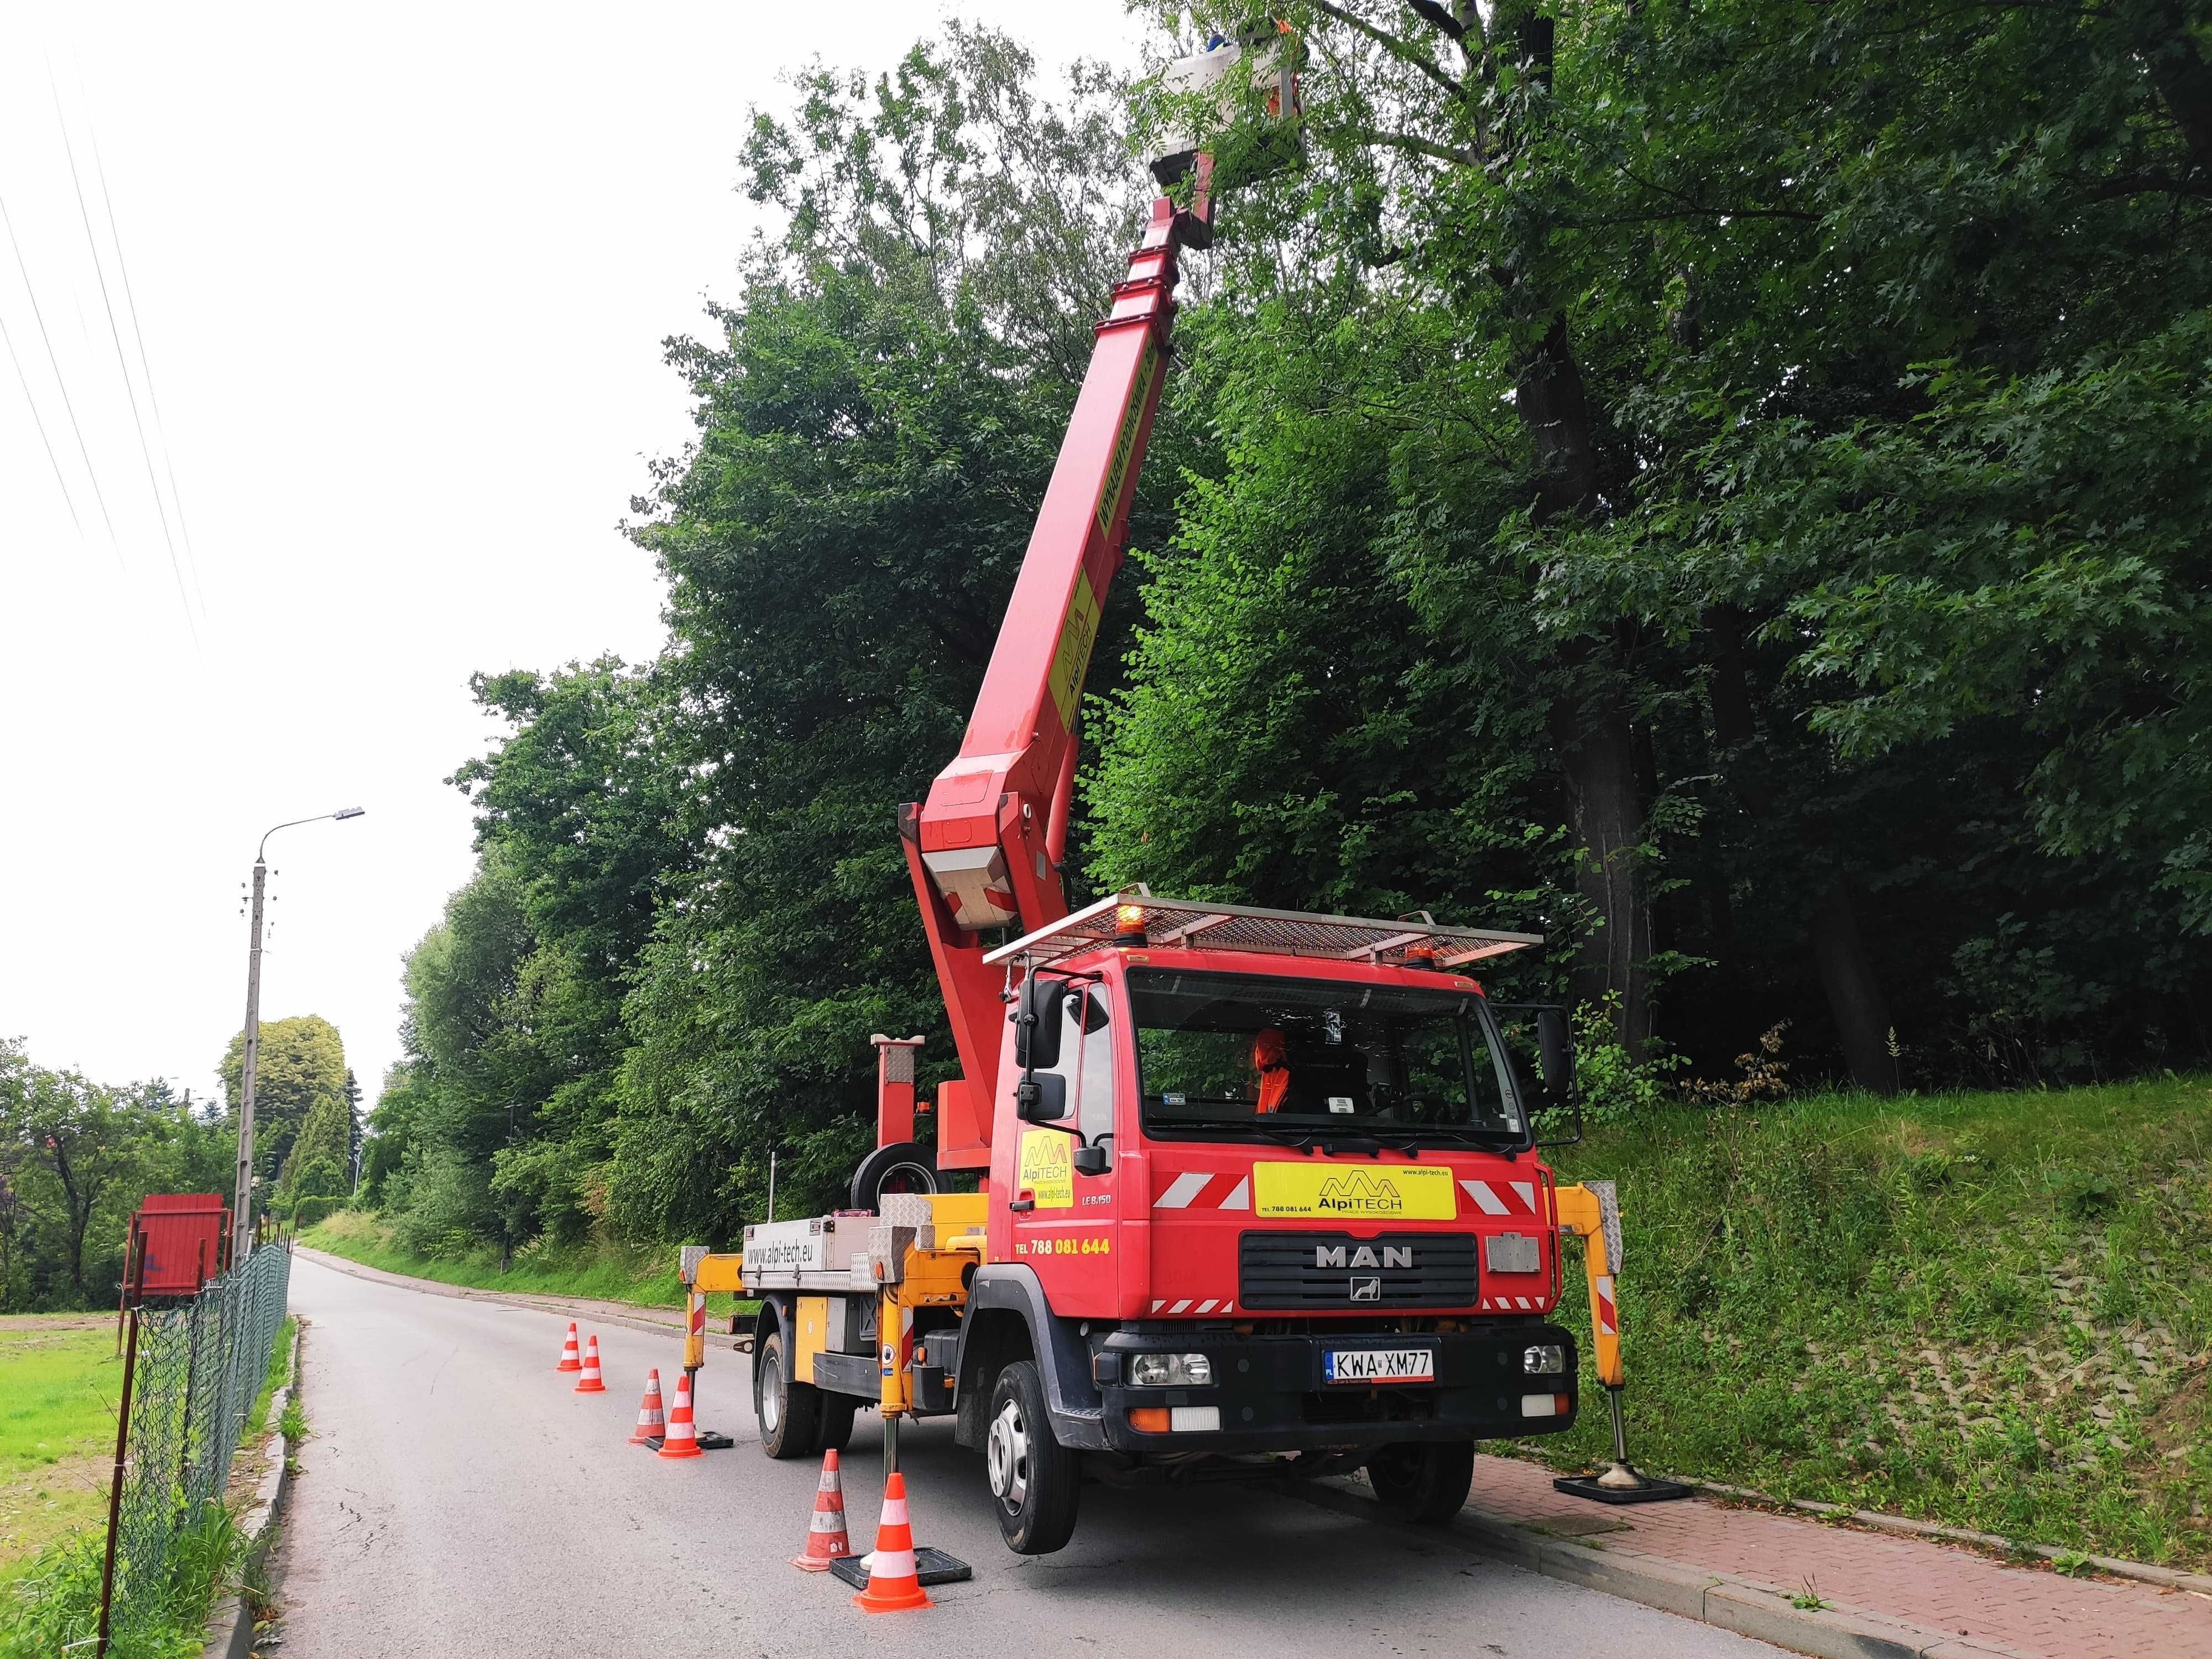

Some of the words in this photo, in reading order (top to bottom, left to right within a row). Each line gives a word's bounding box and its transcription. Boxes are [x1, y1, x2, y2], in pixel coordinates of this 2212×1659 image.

[1099, 449, 1124, 528] WYNAJEM
[1120, 372, 1147, 460] PODNOŚNIKA
[1069, 623, 1091, 698] AlpiTECH
[1023, 1166, 1067, 1182] AlpiTECH
[1037, 1186, 1071, 1203] www.alpi-tech.eu
[1318, 1198, 1402, 1211] AlpiTECH
[748, 1238, 813, 1270] www.alpi-tech.eu
[1015, 1243, 1028, 1255] TEL
[1031, 1239, 1052, 1255] 788
[1055, 1239, 1078, 1255] 081
[1081, 1238, 1110, 1255] 644
[1316, 1246, 1412, 1268] MAN
[1337, 1354, 1378, 1377] KWA
[1385, 1352, 1429, 1375] XM77
